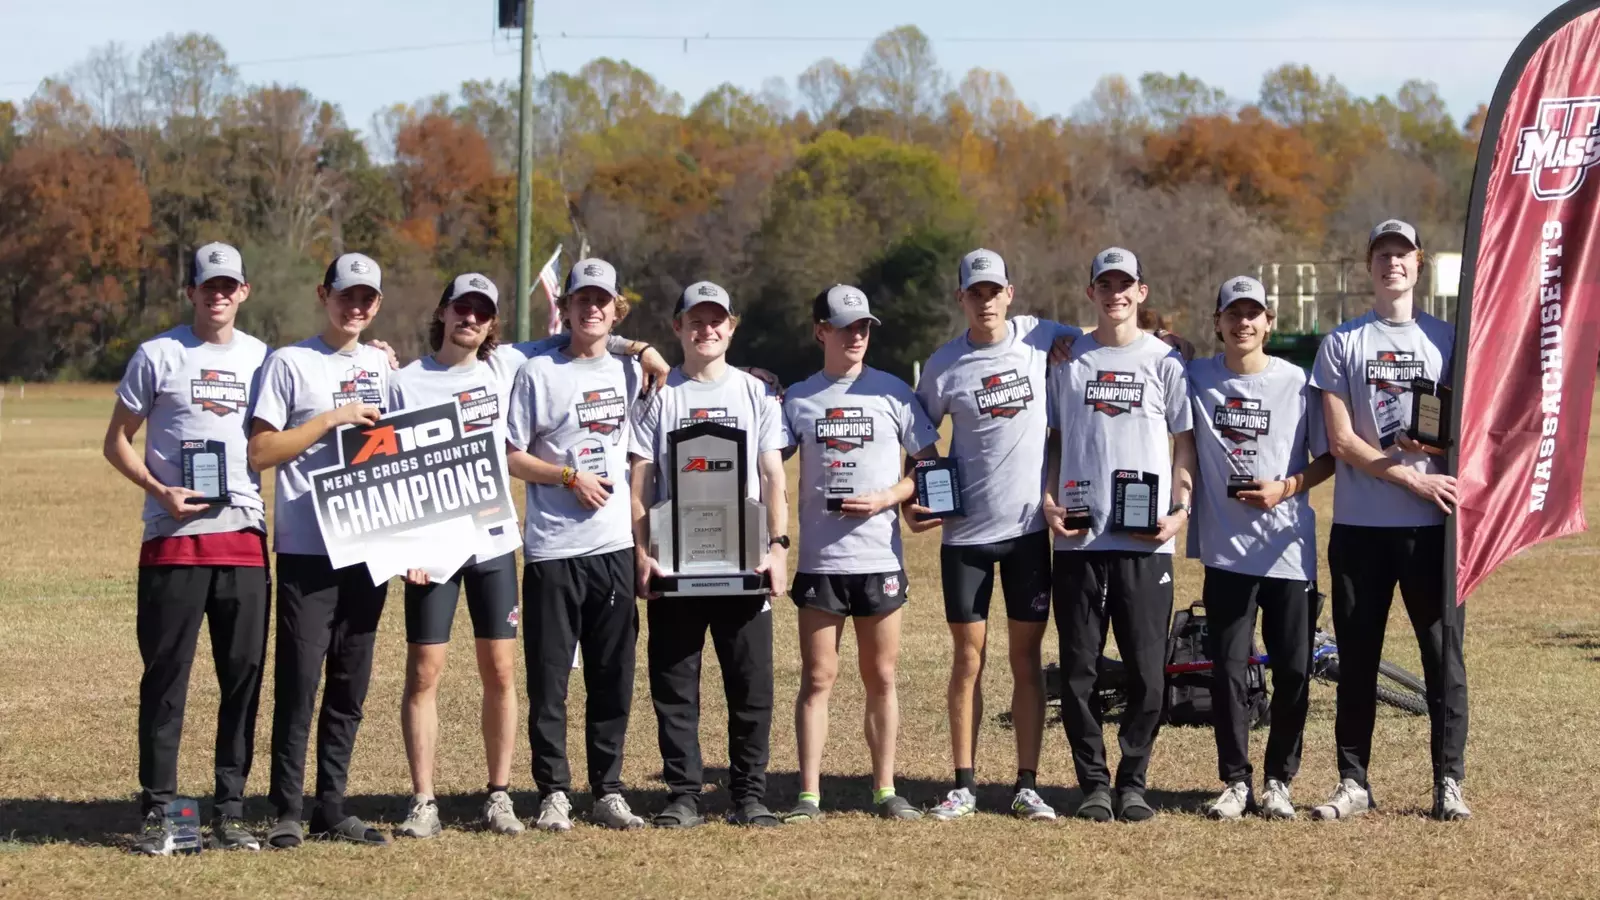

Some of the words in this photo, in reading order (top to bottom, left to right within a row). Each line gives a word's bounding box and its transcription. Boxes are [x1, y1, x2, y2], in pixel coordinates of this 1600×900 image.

[1368, 366, 1422, 380] CHAMPIONS
[1528, 220, 1563, 513] MASSACHUSETTS
[1099, 373, 1133, 382] A10
[193, 386, 246, 401] CHAMPIONS
[978, 383, 1031, 408] CHAMPIONS
[1087, 386, 1142, 401] CHAMPIONS
[462, 400, 498, 422] AMPIONS
[579, 403, 625, 422] CHAMPIONS
[829, 408, 861, 419] A10
[1215, 412, 1268, 429] CHAMPIONS
[817, 423, 872, 437] CHAMPIONS
[350, 417, 454, 465] A10
[322, 470, 367, 492] MEN'S
[372, 456, 419, 480] CROSS
[424, 439, 488, 467] COUNTRY
[681, 456, 734, 472] A10
[829, 460, 856, 468] A10
[1064, 480, 1091, 489] A10
[326, 457, 498, 539] CHAMPIONS
[1116, 483, 1124, 503] TEAM
